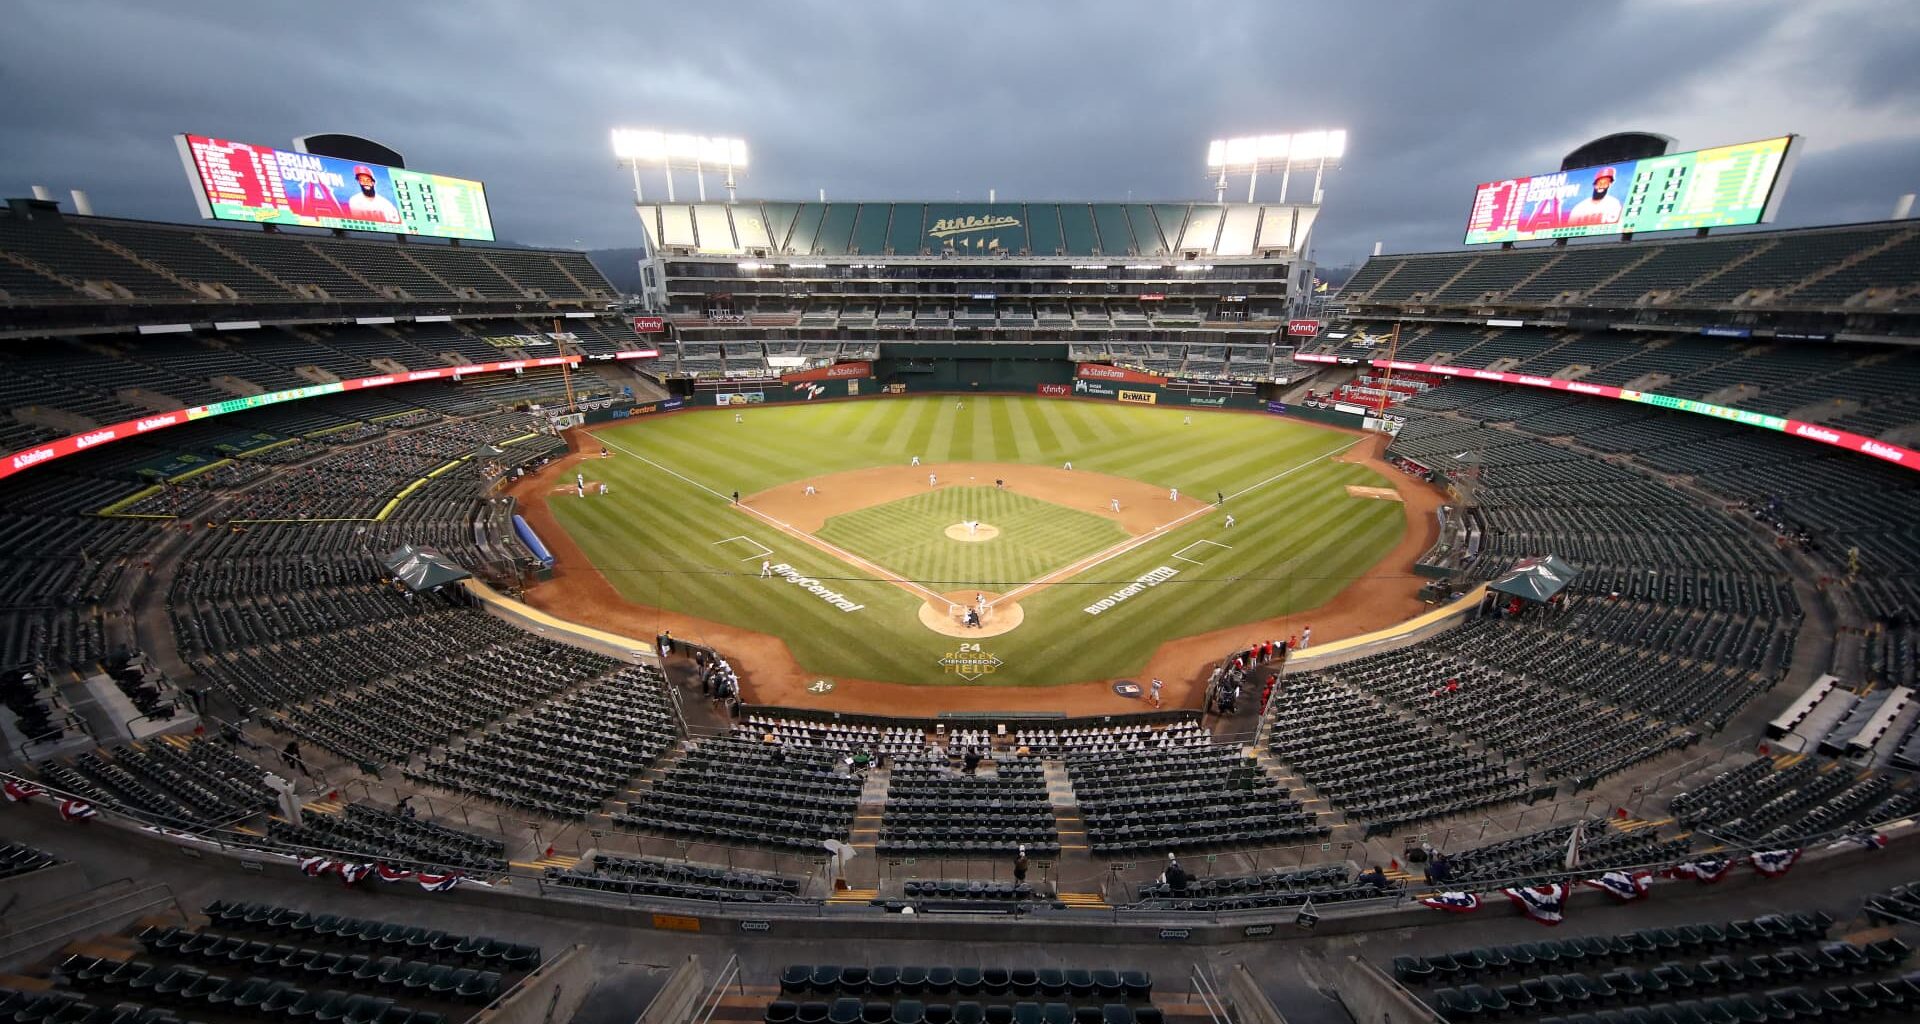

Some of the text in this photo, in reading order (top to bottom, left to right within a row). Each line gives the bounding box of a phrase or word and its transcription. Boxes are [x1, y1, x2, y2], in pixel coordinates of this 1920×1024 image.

[274, 150, 323, 171] BRIAN
[279, 166, 344, 187] GOODWIN
[1531, 174, 1567, 191] BRIAN
[1526, 184, 1580, 202] GOODWIN
[927, 214, 1020, 237] Athletics
[636, 321, 662, 330] xfinity
[1291, 323, 1317, 332] xfinity
[1042, 384, 1066, 395] xfinity
[613, 404, 656, 418] RingCentral
[769, 563, 865, 612] RingCentral
[1083, 599, 1116, 615] BUD
[1108, 583, 1147, 602] LIGHT
[960, 643, 981, 653] 24
[944, 664, 996, 673] FIELD
